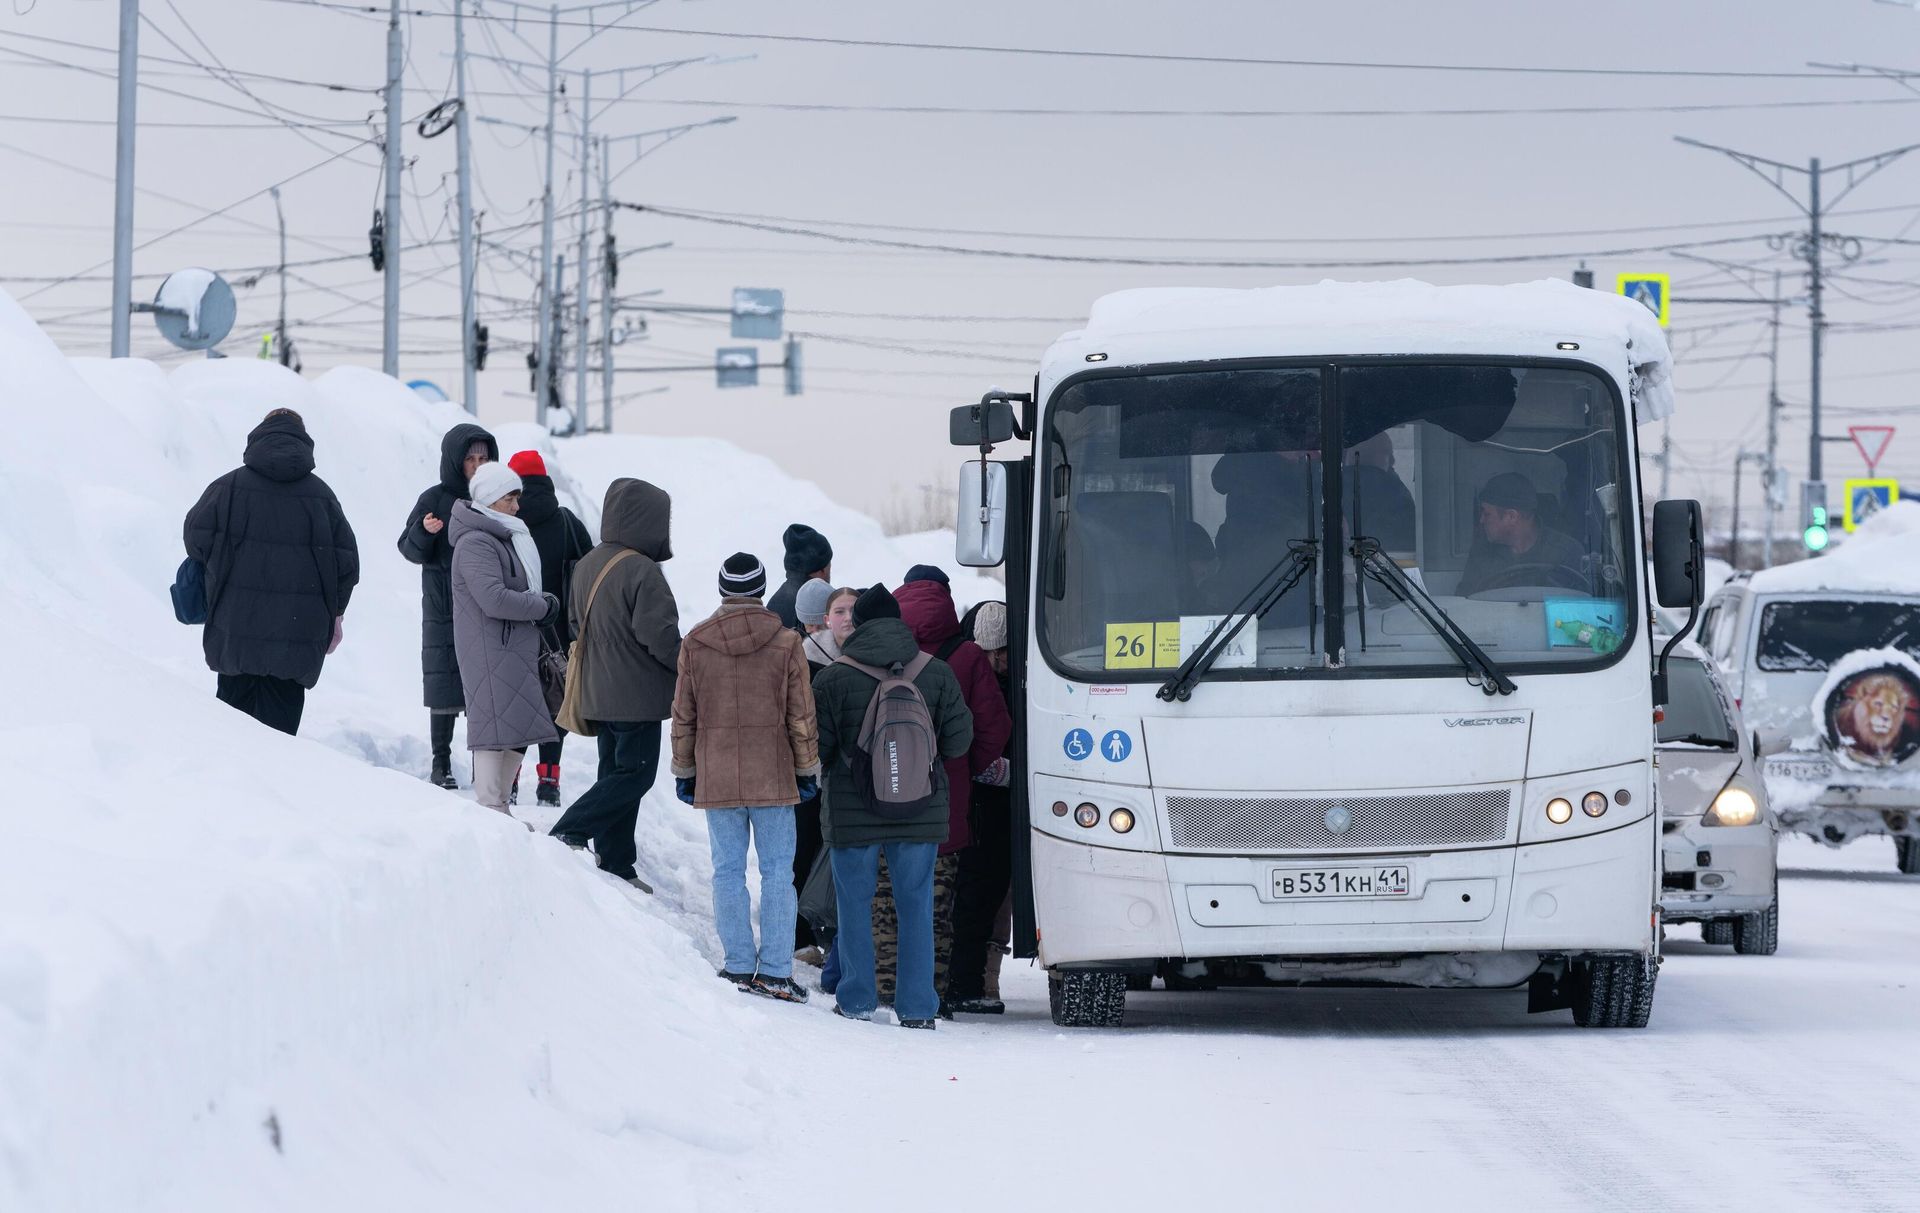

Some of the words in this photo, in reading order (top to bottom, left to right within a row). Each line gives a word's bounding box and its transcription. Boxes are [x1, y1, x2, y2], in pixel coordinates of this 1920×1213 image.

[1114, 635, 1145, 657] 26
[891, 776, 899, 793] BAG
[1378, 869, 1400, 886] 41
